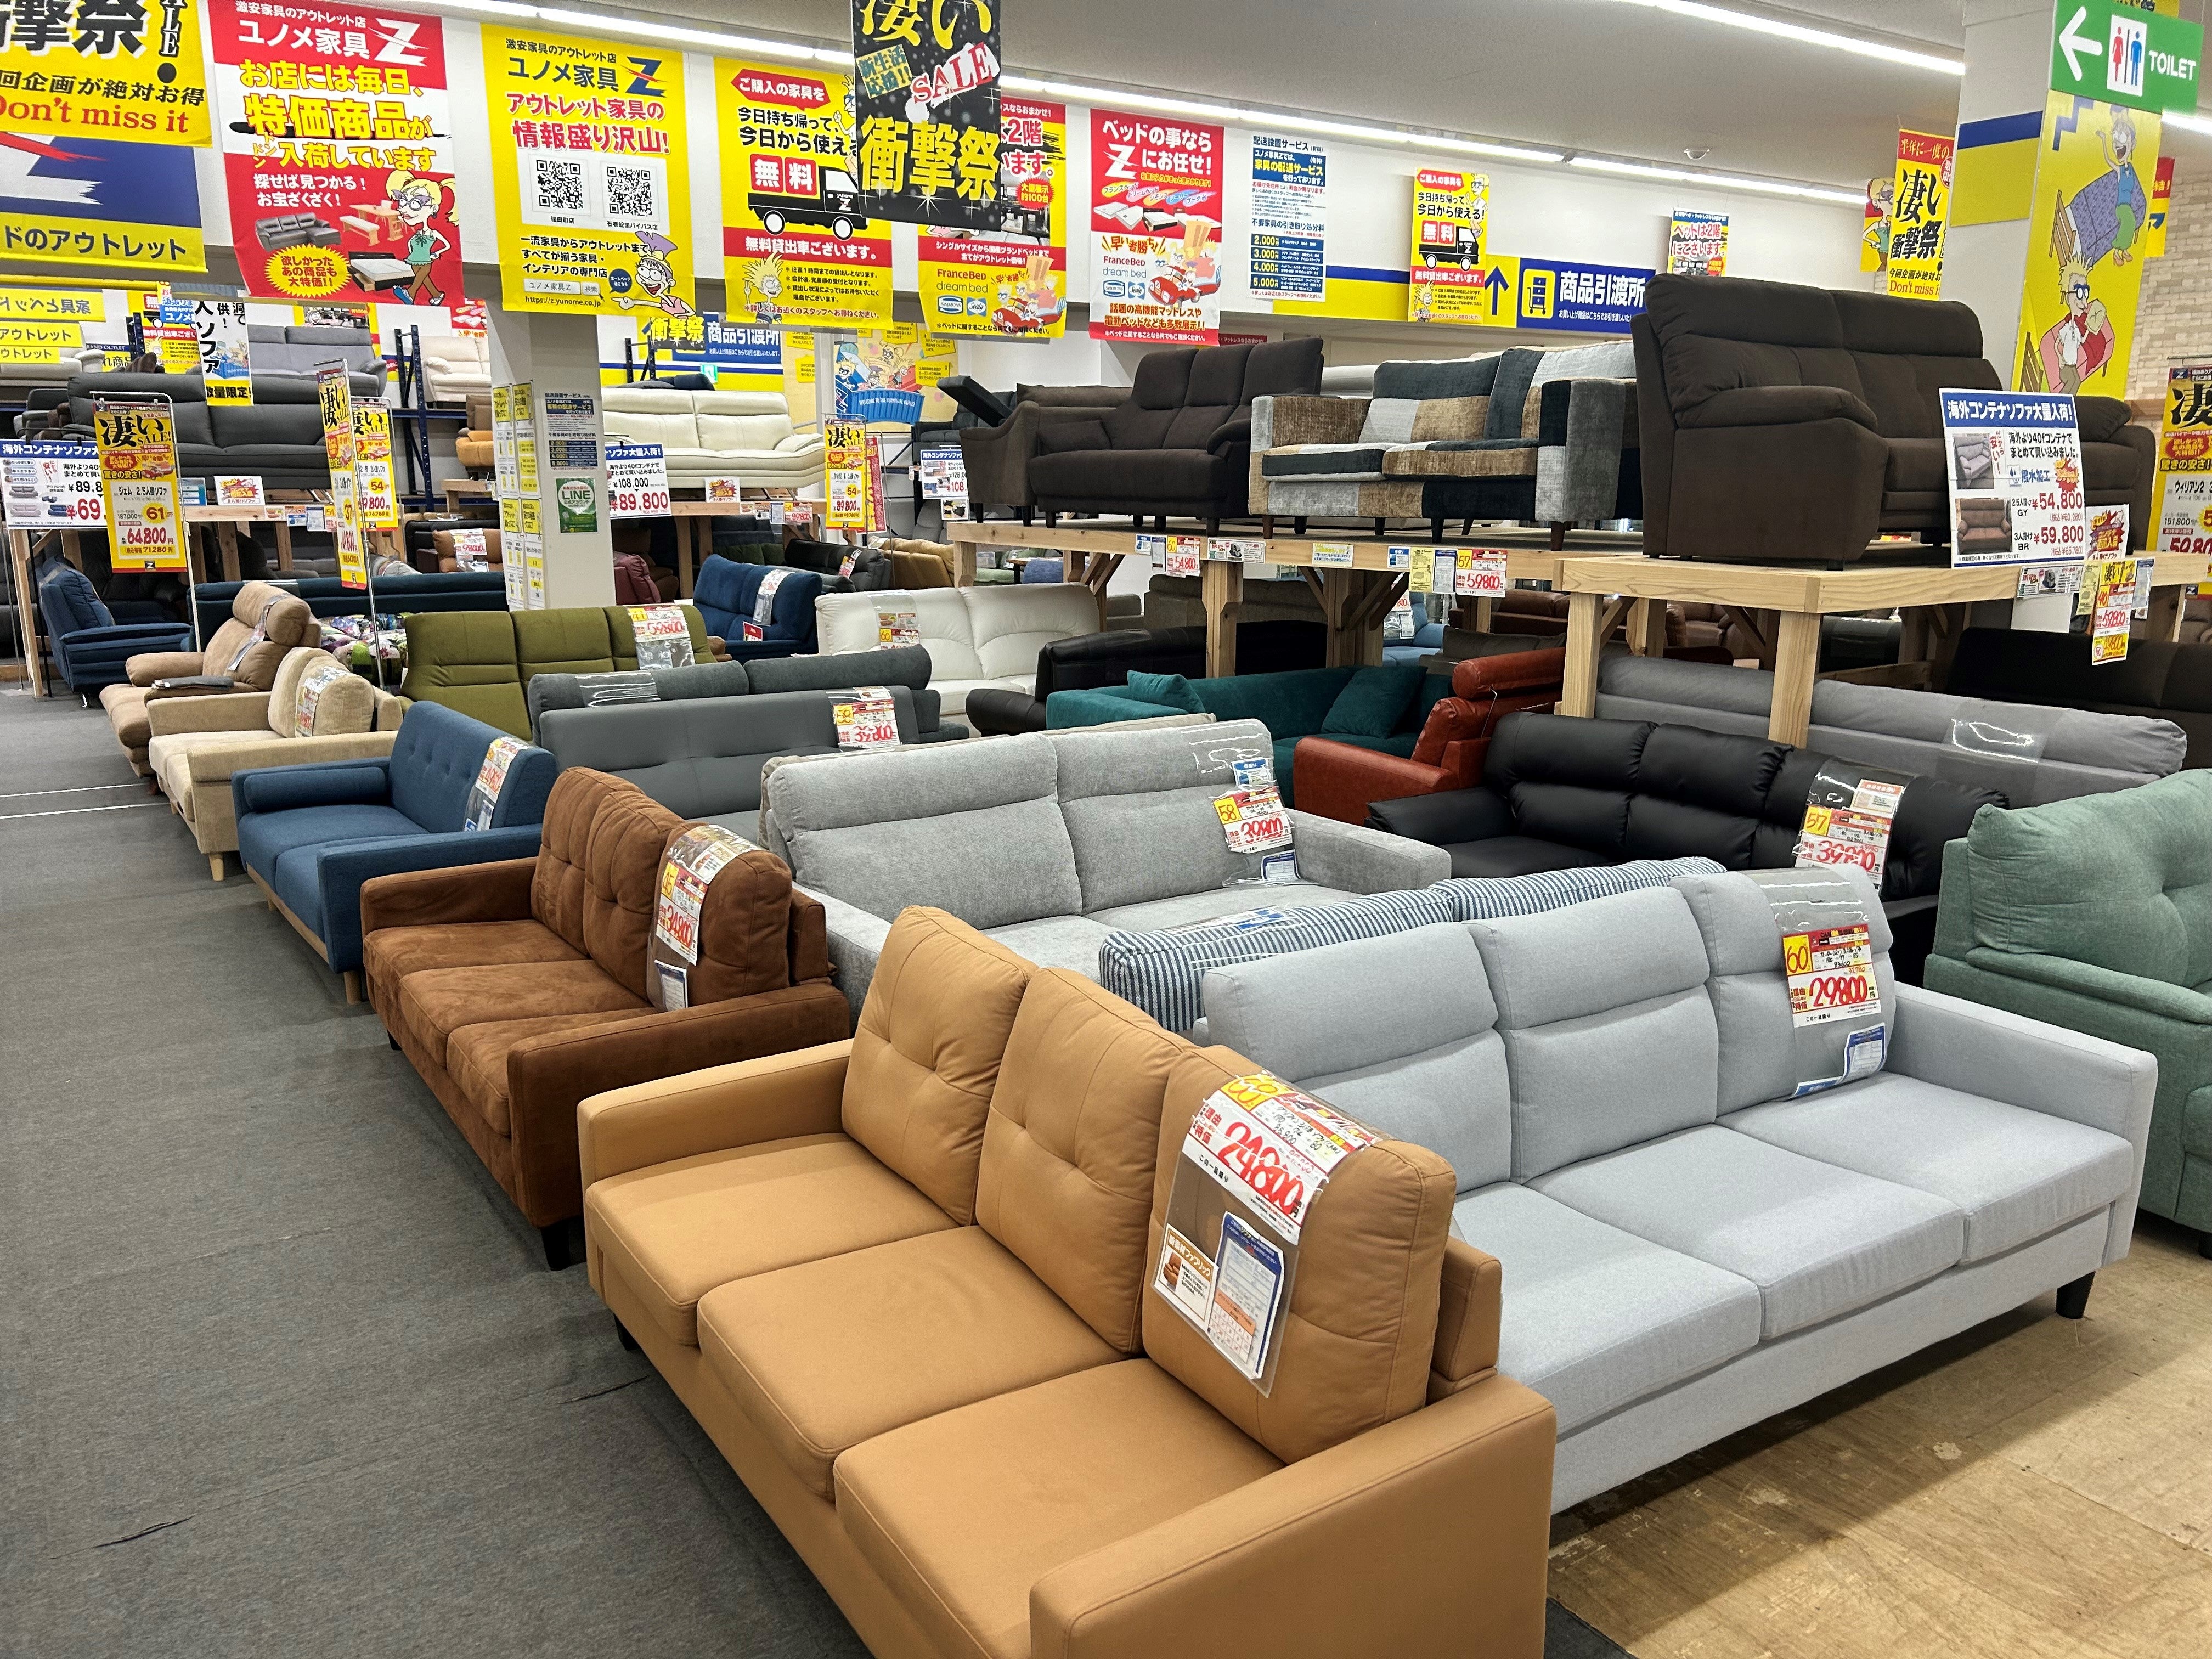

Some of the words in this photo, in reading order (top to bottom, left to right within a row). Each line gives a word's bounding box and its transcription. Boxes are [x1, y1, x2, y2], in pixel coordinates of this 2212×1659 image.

[235, 1, 366, 28] 激安家具のアウトレット店
[505, 38, 617, 64] 激安家具のアウトレット店
[858, 46, 906, 78] 新生活
[2148, 50, 2197, 81] TOILET
[239, 58, 423, 97] お店には毎日、
[911, 41, 994, 104] SALE
[739, 77, 825, 101] ご購入の家具を
[506, 93, 665, 121] アウトレット家具の
[81, 105, 157, 131] miss
[166, 110, 189, 133] it
[244, 93, 433, 141] 特価商品が
[512, 120, 670, 154] 情報盛り沢山!
[1102, 120, 1212, 153] ベッドの事なら
[1253, 136, 1309, 151] 配送設置サービス
[278, 142, 436, 172] 入荷しています
[860, 114, 1001, 201] 衝撃祭
[1901, 138, 1950, 161] 半年に一度の
[1142, 149, 1212, 175] にお任せ!
[1255, 159, 1323, 176] 家具の配送サービス
[253, 173, 366, 190] 探せば見つかる!
[754, 159, 813, 191] 無料
[1283, 173, 1324, 185] を行っております。
[257, 192, 341, 208] お宝ざくざく!
[1021, 192, 1049, 204] 約100台
[1418, 204, 1485, 220] 今日から使える!
[5, 225, 186, 261] ドのアウトレット
[520, 235, 648, 253] 一流家具からアウトレットまで
[745, 236, 876, 261] 無料貸出車ございます。
[1890, 220, 1943, 259] 衝撃祭
[281, 256, 334, 266] 欲しかった
[281, 266, 338, 277] あの商品も
[522, 263, 607, 278] インテリアの専門店
[1102, 267, 1129, 277] dream
[1130, 268, 1147, 278] bed
[288, 277, 334, 287] 大特価!!
[936, 281, 968, 292] dream
[969, 283, 988, 293] bed
[1130, 285, 1143, 295] Sealy
[1560, 270, 1645, 308] 商品引渡所
[1889, 280, 1912, 292] Don't
[1914, 284, 1933, 295] miss
[525, 295, 601, 308] https://z.yunome.co.jp
[969, 301, 984, 312] Sealy
[1110, 303, 1202, 318] 話題の高機能マットレスや
[651, 317, 704, 341] 衝撃祭
[1104, 315, 1205, 331] 電動ベッドなども多数展示!!
[707, 320, 780, 346] 商品引渡所
[1947, 400, 2073, 421] 海外コンテナソファ大量入荷!
[2170, 383, 2212, 429] 凄
[98, 415, 164, 448] 凄い
[827, 427, 860, 448] 凄い
[2008, 432, 2073, 444] 海外より40fコンテナで
[1990, 435, 2001, 475] 安い!
[2010, 447, 2079, 458] まとめて買い込みました。
[613, 477, 649, 488] ¥108,000
[2021, 469, 2050, 483] 撥水加工
[371, 481, 383, 490] 54
[847, 487, 857, 495] 54
[562, 490, 591, 500] LINE
[610, 492, 668, 511] ¥89,800
[2032, 492, 2083, 510] ¥54,800
[146, 507, 165, 520] 61
[2033, 525, 2084, 544] ¥59,800
[1167, 541, 1176, 552] 60
[1458, 555, 1471, 568] 57
[881, 631, 890, 641] 60
[1218, 804, 1237, 822] 58
[1806, 812, 1827, 832] 57
[1786, 945, 1809, 973] 60
[1809, 975, 1868, 1007] 29800
